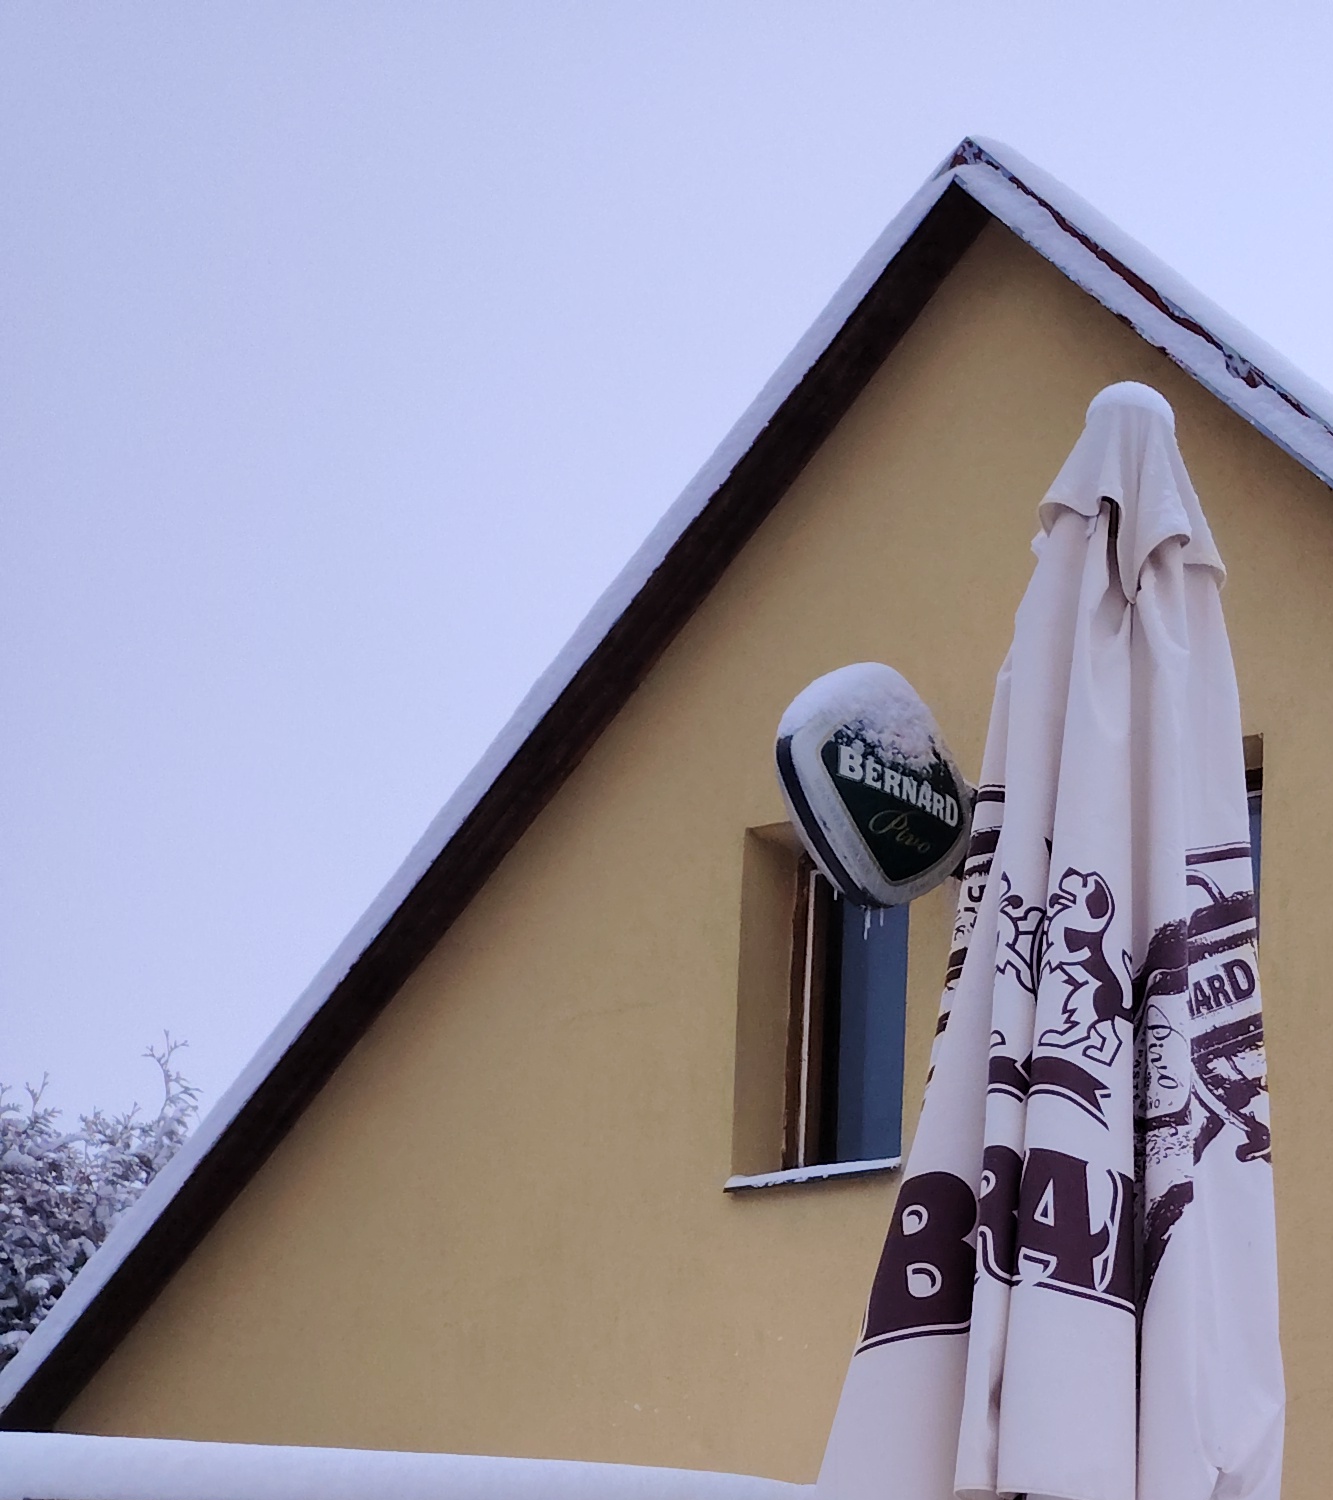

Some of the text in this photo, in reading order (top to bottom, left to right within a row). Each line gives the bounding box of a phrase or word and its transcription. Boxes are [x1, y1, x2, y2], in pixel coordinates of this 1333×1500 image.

[837, 744, 960, 828] BERNARD
[868, 810, 931, 853] Pivo
[1187, 958, 1257, 1018] ARD
